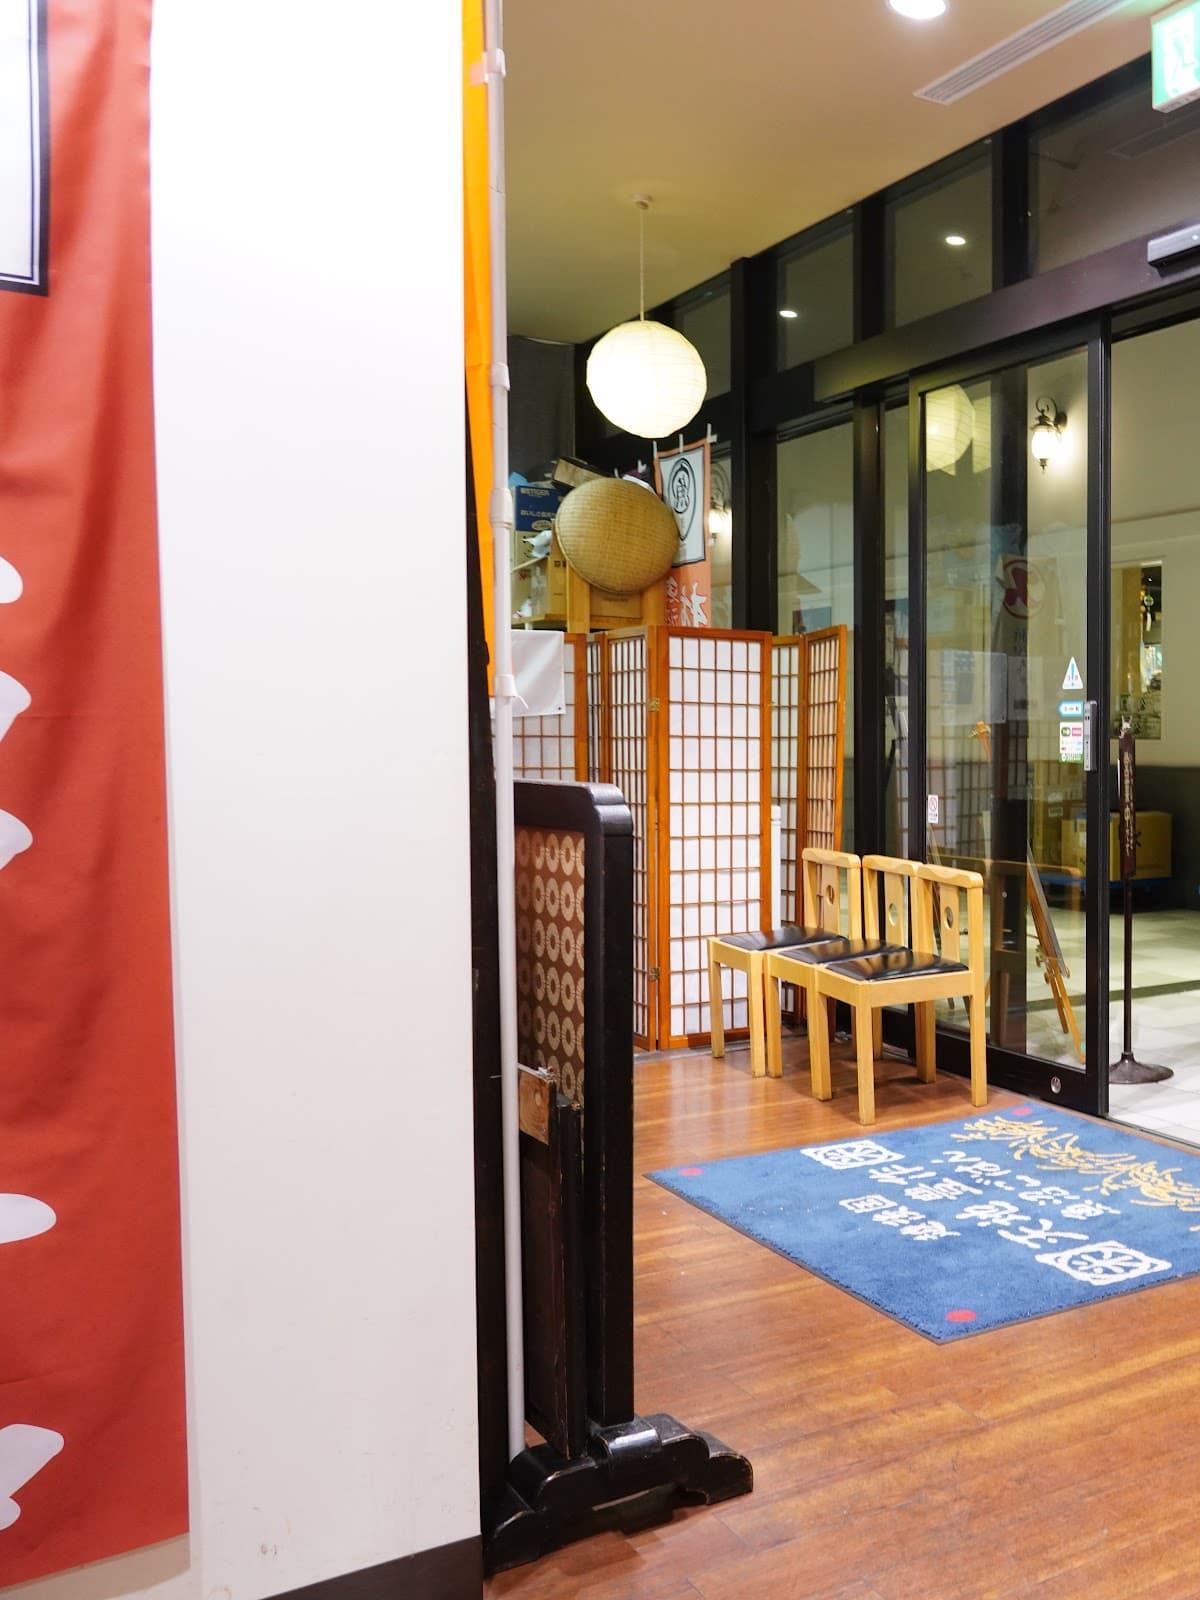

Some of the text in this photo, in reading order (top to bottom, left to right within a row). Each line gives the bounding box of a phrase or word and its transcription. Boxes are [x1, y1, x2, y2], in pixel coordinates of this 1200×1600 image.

[868, 1162, 1090, 1249] 天地豊作
[942, 1149, 1121, 1220] 魚沼ごはん
